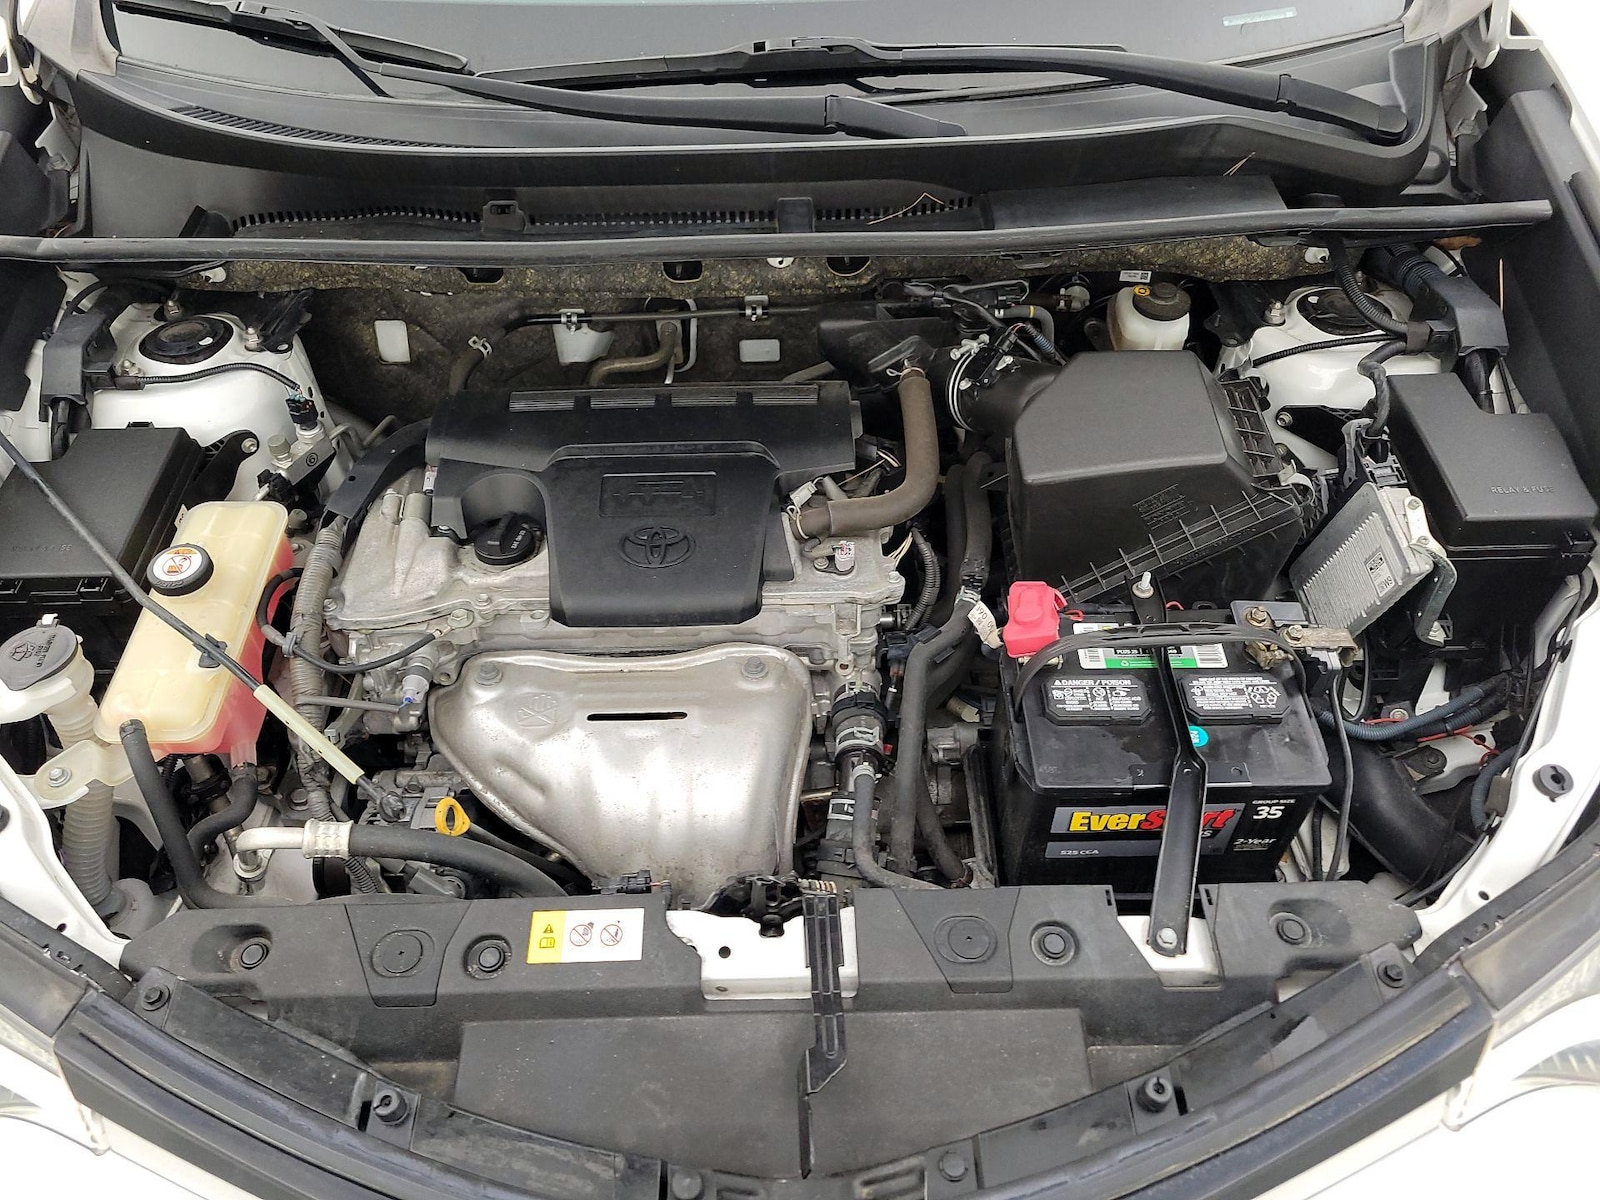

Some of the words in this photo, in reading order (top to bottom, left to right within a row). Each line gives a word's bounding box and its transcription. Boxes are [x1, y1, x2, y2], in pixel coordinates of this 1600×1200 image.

[1490, 485, 1520, 495] RELAY
[1069, 808, 1237, 832] EverSrt
[1253, 806, 1285, 820] 35
